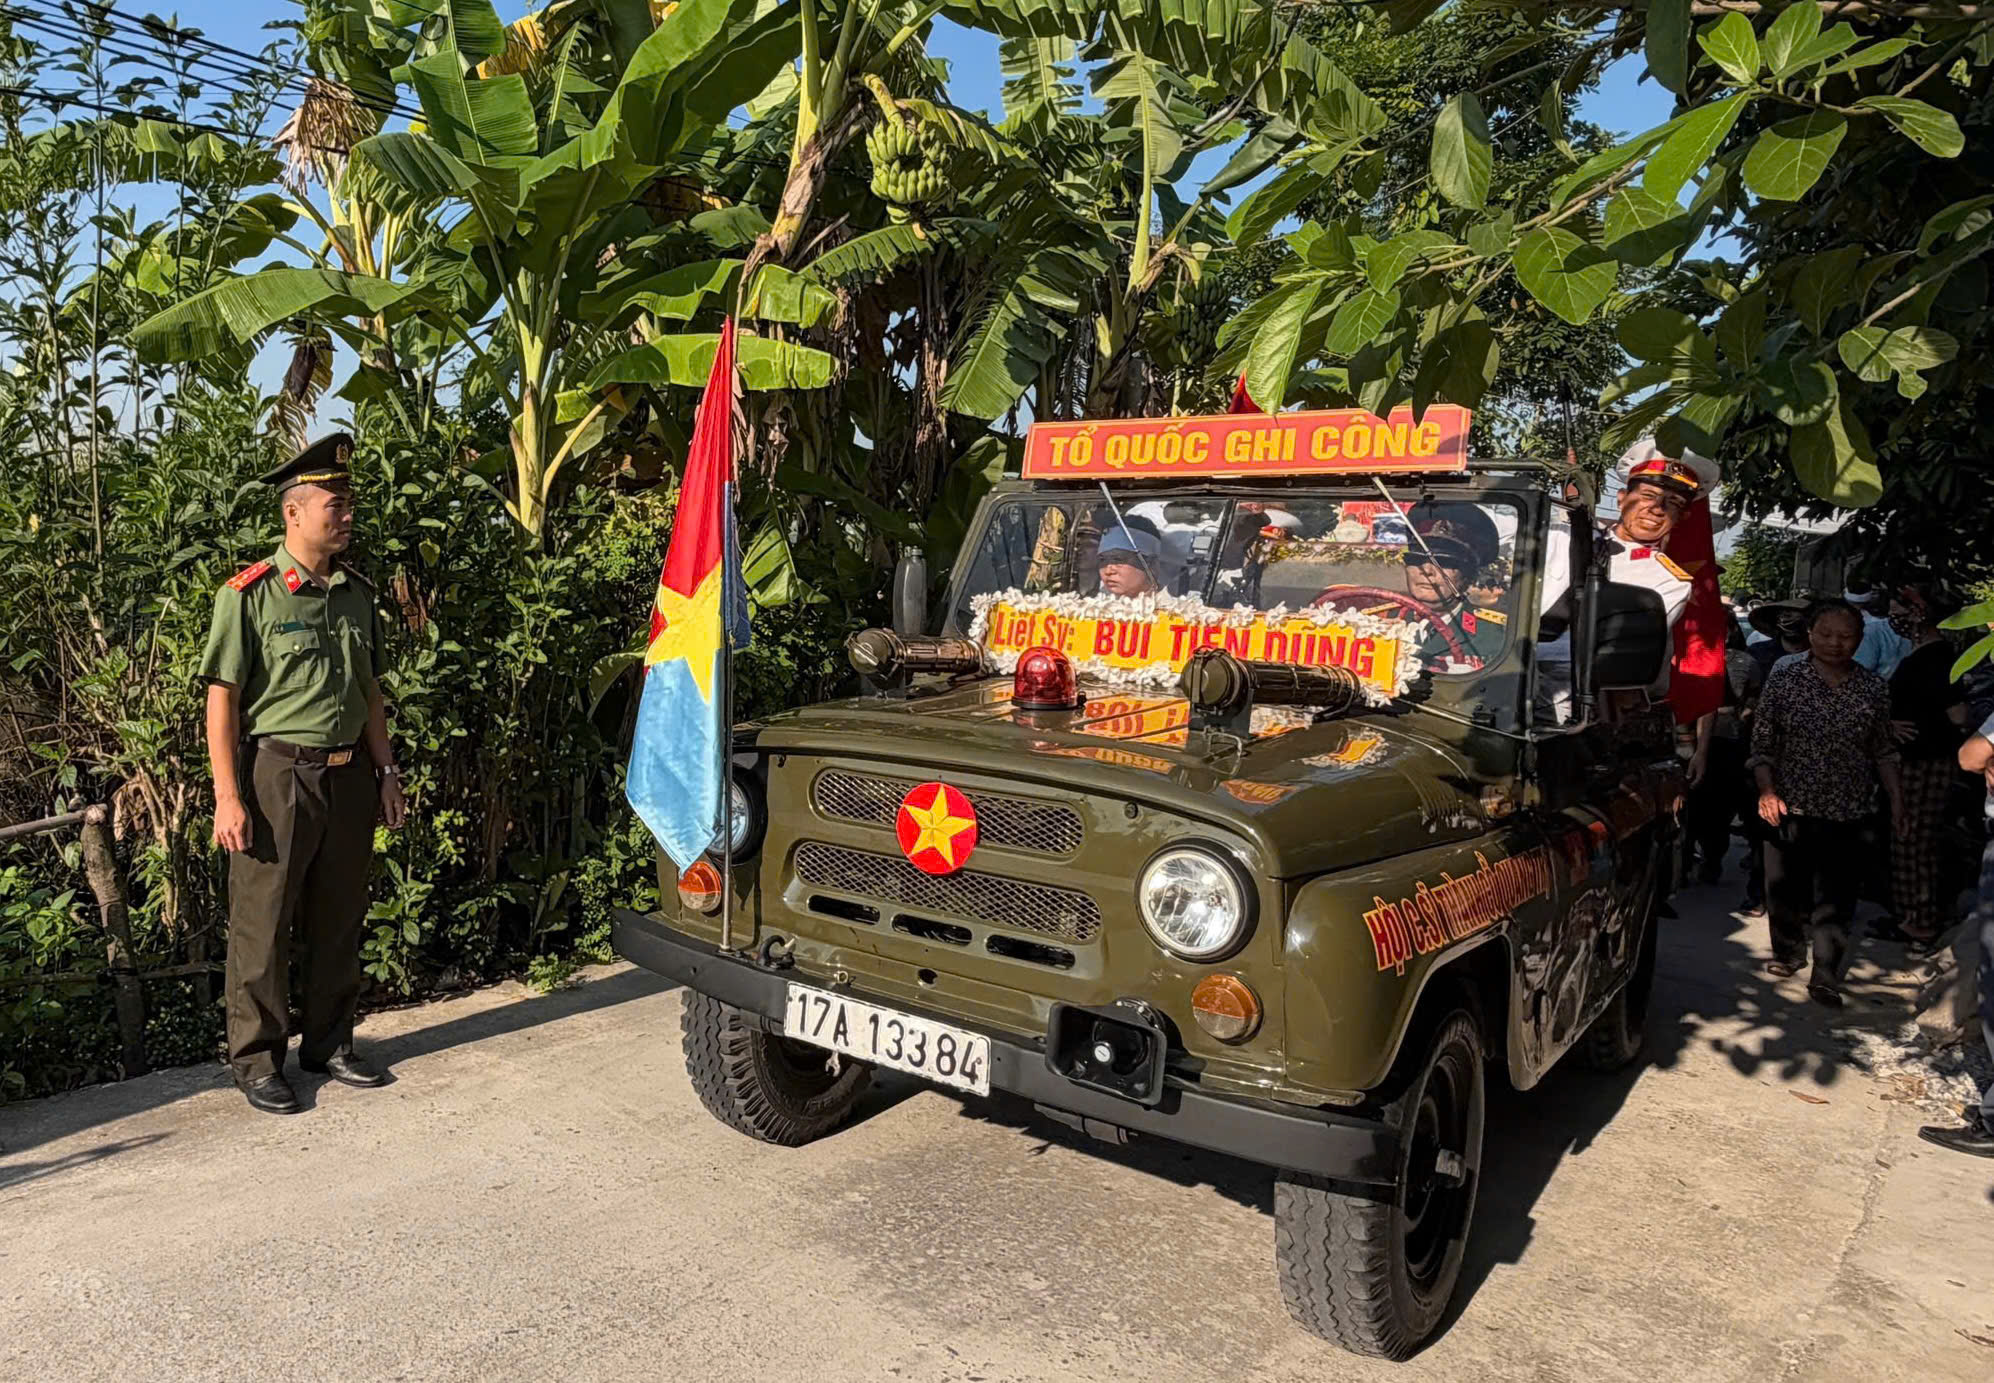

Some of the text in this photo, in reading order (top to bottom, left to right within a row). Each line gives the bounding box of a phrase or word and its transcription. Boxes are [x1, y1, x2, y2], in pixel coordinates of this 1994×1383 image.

[1049, 415, 1441, 469] TỔ QUỐC GHI CÔNG
[1363, 896, 1413, 976] HỘI
[798, 993, 979, 1085] 17A 13384
